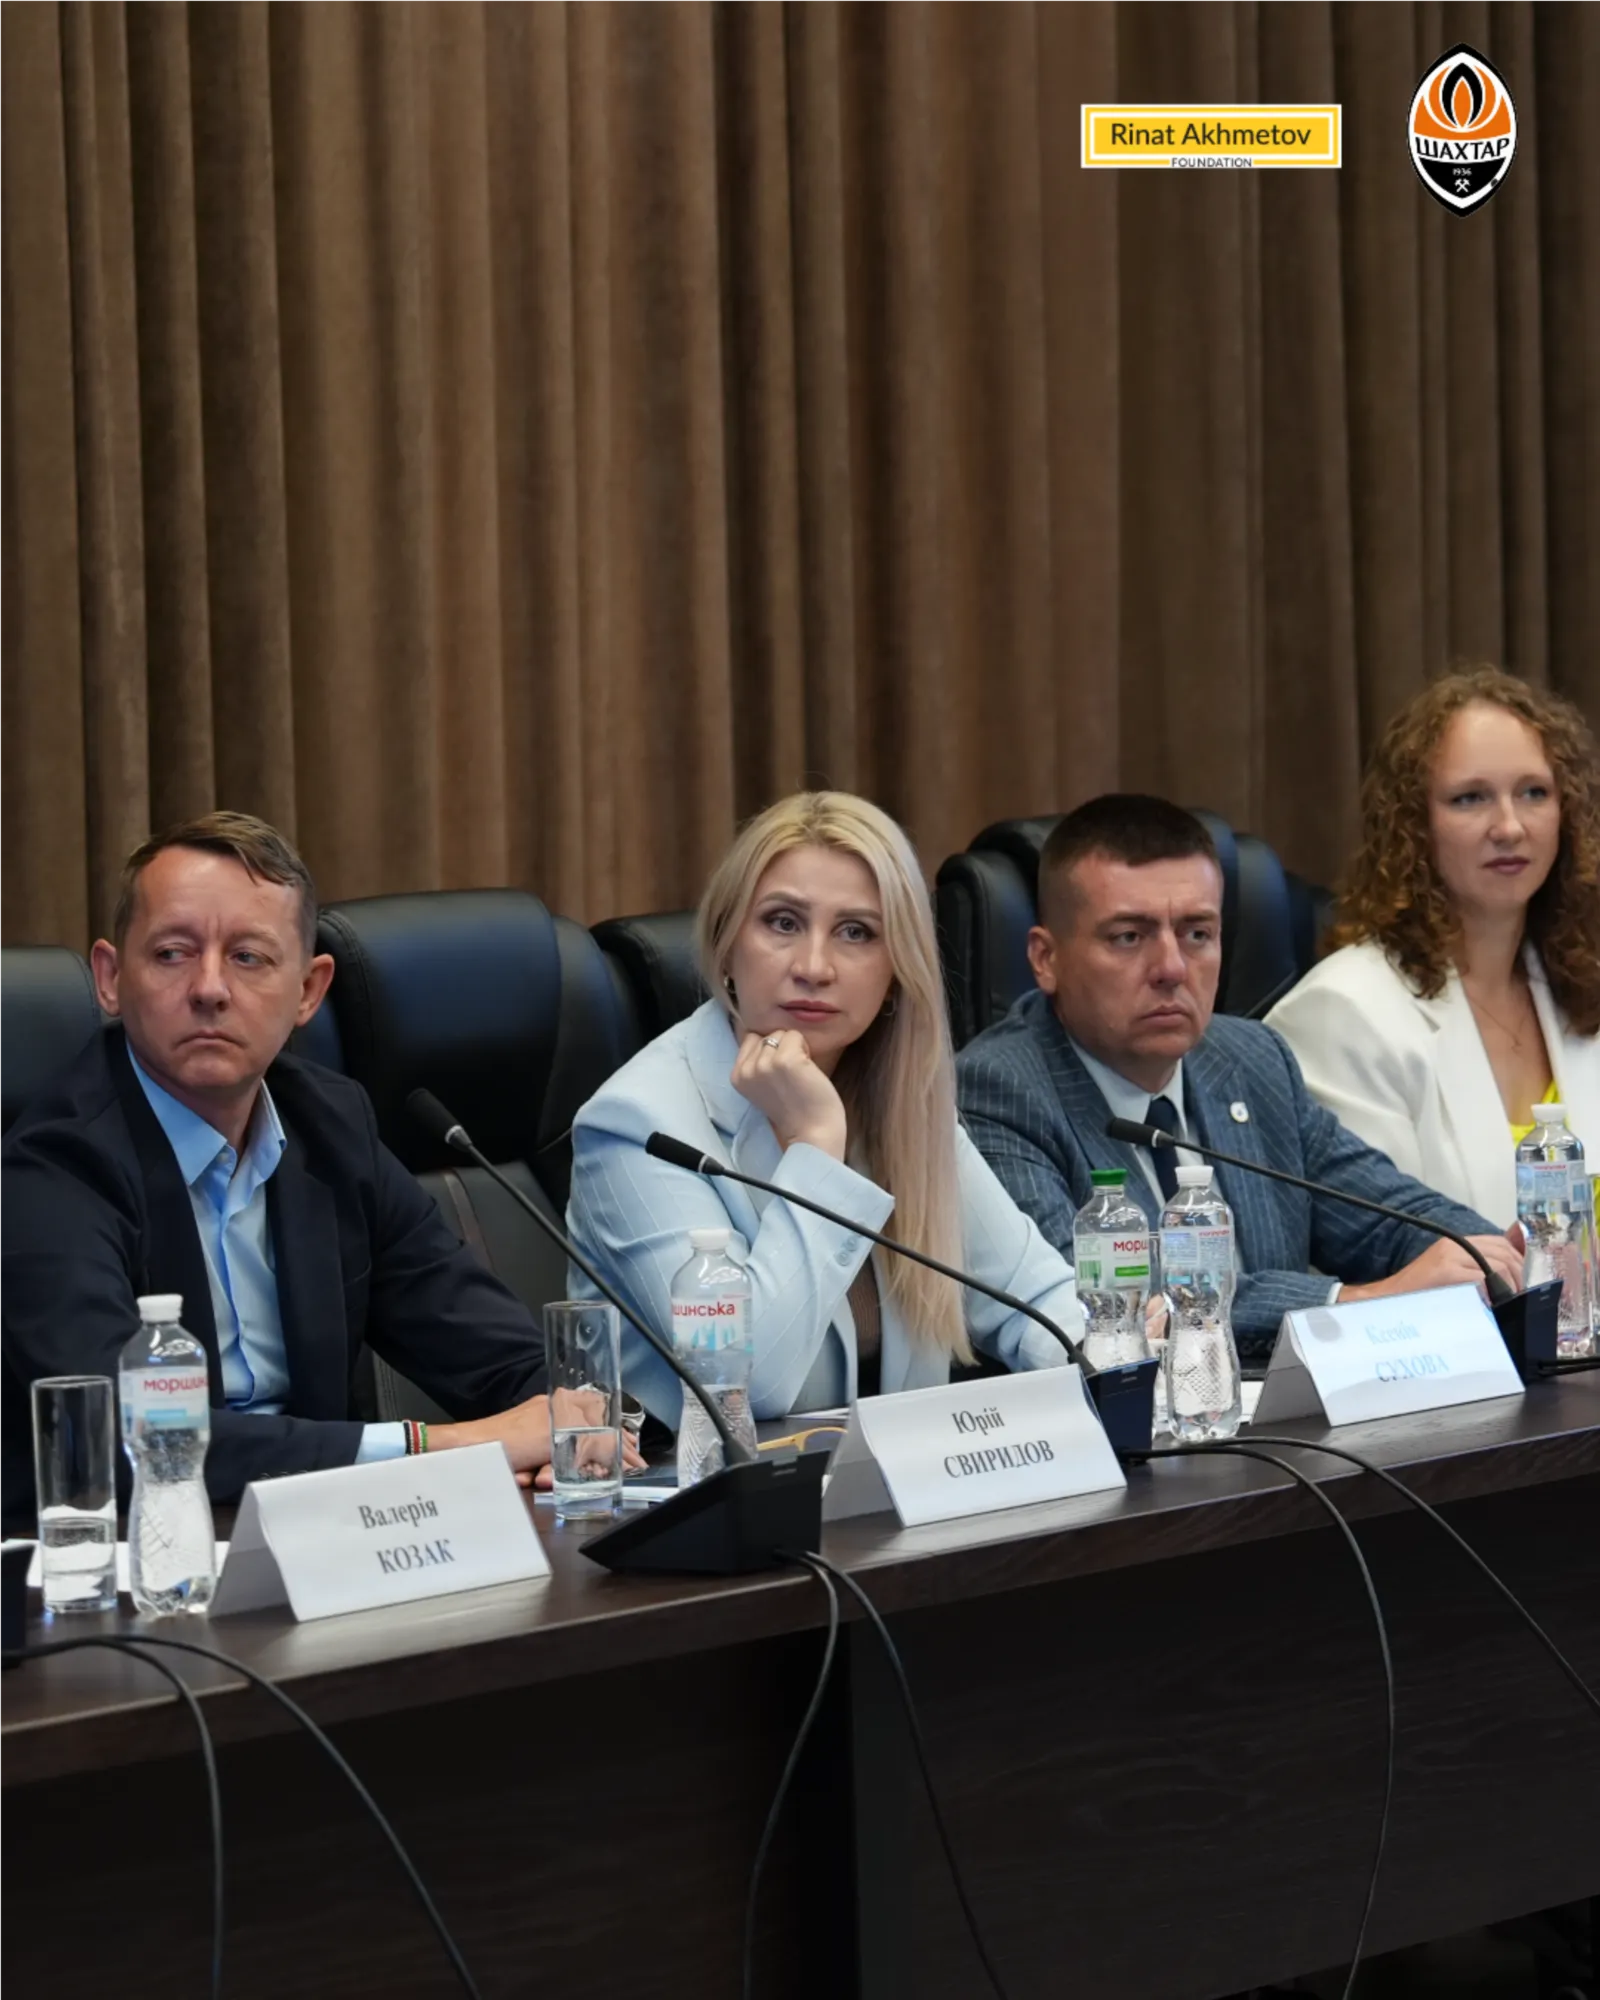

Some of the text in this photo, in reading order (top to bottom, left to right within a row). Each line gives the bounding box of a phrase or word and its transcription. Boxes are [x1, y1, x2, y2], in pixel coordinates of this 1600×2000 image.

[1375, 1354, 1449, 1382] СУХОВА
[951, 1406, 1005, 1436] Юрій
[943, 1439, 1054, 1478] СВИРИДОВ
[357, 1495, 439, 1529] Валерія
[376, 1538, 456, 1574] КОЗАК
